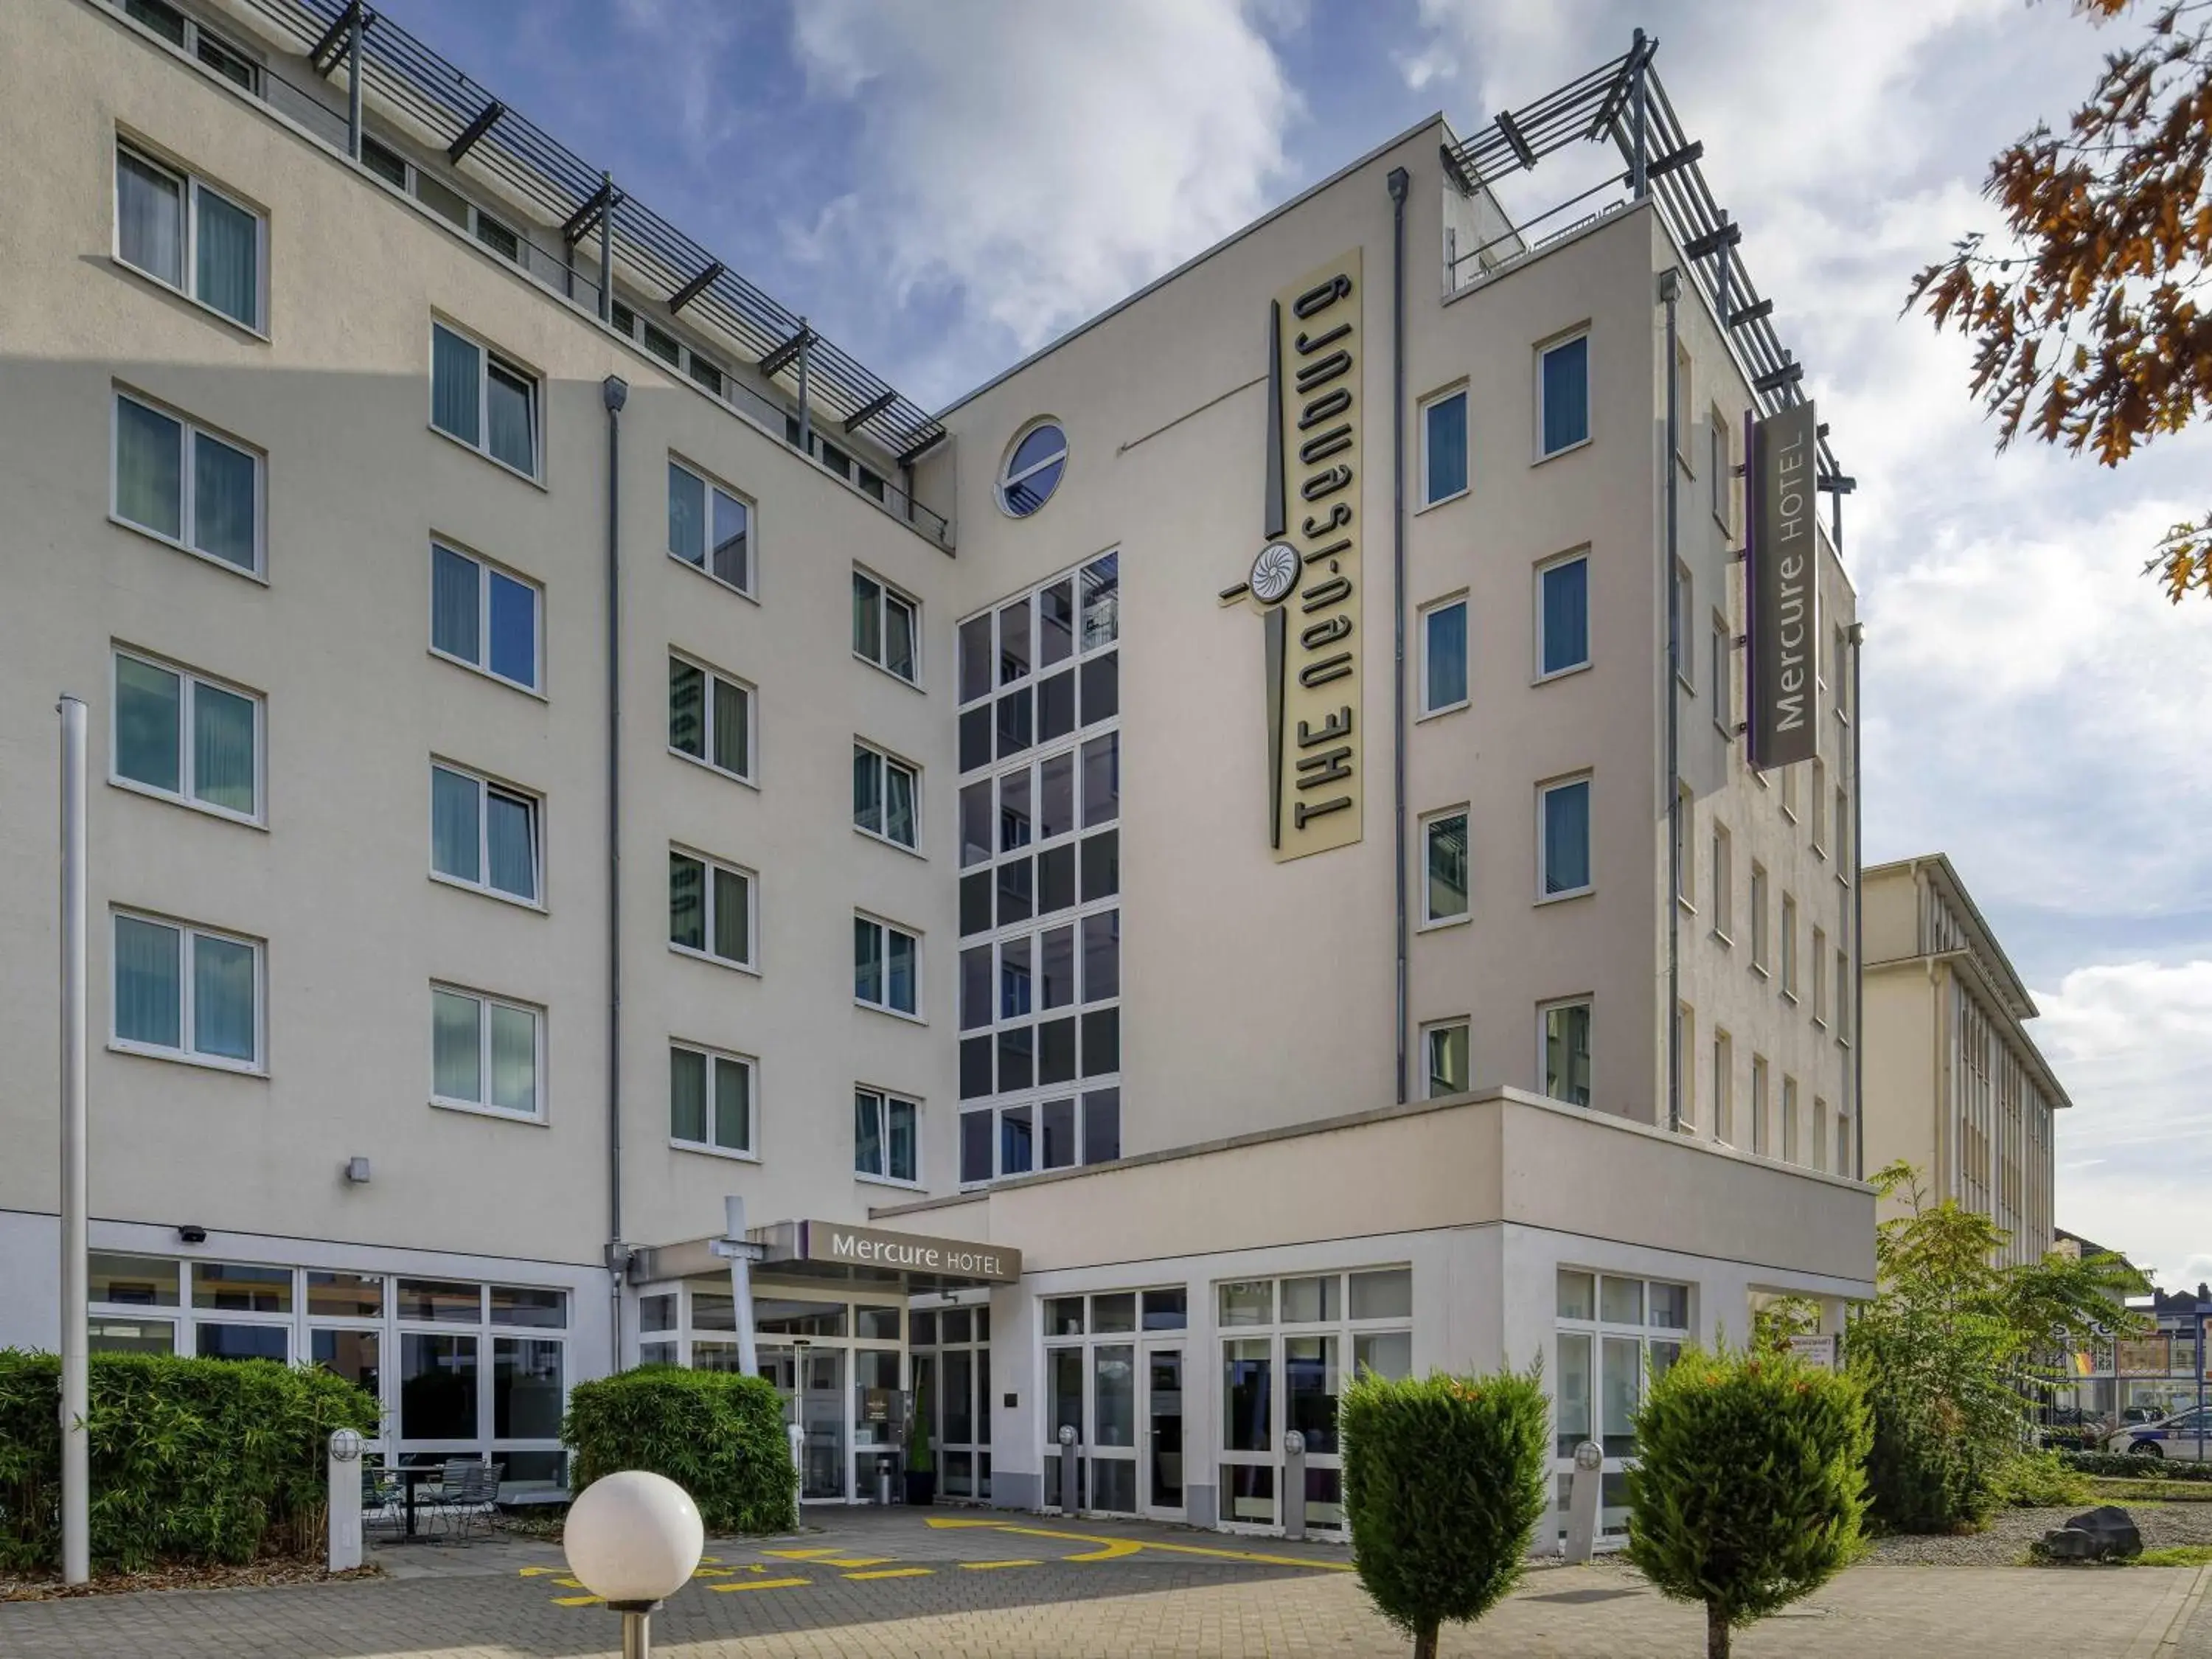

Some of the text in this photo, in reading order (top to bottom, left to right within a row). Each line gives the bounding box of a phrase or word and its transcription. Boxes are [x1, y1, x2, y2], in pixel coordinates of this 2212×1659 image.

[1775, 430, 1804, 733] Mercure HOTEL
[1294, 706, 1352, 830] THE
[832, 1233, 1004, 1276] Mercure HOTEL
